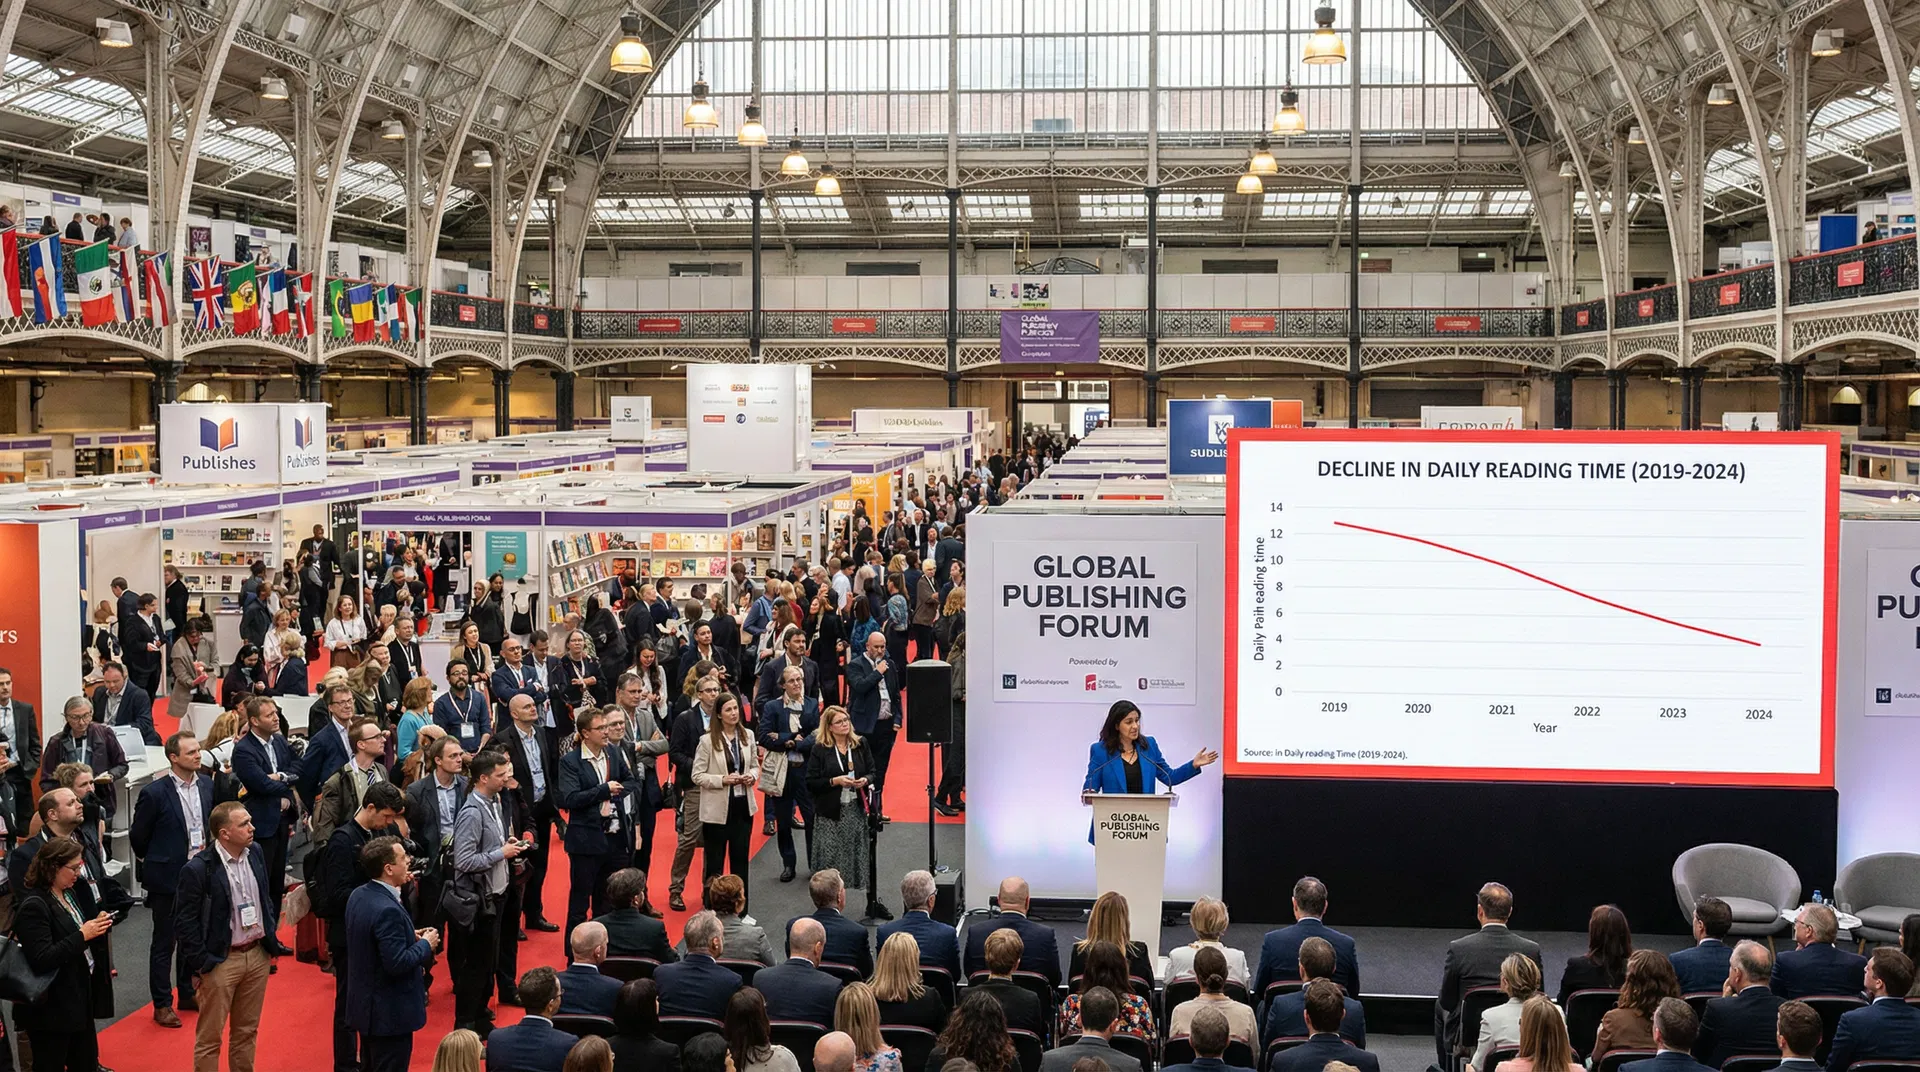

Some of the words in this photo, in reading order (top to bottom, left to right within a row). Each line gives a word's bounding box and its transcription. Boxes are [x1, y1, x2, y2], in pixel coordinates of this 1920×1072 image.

[182, 455, 257, 470] Publishes
[1318, 460, 1396, 478] DECLINE
[1401, 461, 1421, 478] IN
[1427, 461, 1481, 478] DAILY
[1486, 462, 1572, 479] READING
[1577, 462, 1626, 479] TIME
[1631, 461, 1746, 484] (2019-2024)
[1270, 502, 1283, 513] 14
[1270, 528, 1283, 539] 12
[1253, 536, 1265, 563] time
[1270, 554, 1284, 566] 10
[1033, 554, 1156, 579] GLOBAL
[1275, 581, 1284, 592] 8
[1003, 584, 1187, 610] PUBLISHING
[1275, 607, 1283, 618] 6
[1039, 614, 1149, 639] FORUM
[1275, 634, 1283, 644] 4
[1252, 632, 1267, 661] Daily
[1108, 658, 1119, 668] by
[1275, 659, 1282, 671] 2
[1275, 686, 1283, 697] 0
[1321, 701, 1348, 713] 2019
[1404, 703, 1432, 714] 2020
[1488, 704, 1516, 715] 2021
[1573, 705, 1601, 717] 2022
[1659, 707, 1687, 719] 2023
[1745, 709, 1773, 720] 2024
[1533, 722, 1558, 734] Year
[1243, 747, 1274, 757] Source:
[1335, 749, 1357, 759] Time
[1110, 812, 1150, 822] GLOBAL
[1100, 822, 1160, 831] PUBLISHING
[1112, 831, 1148, 840] FORUM
